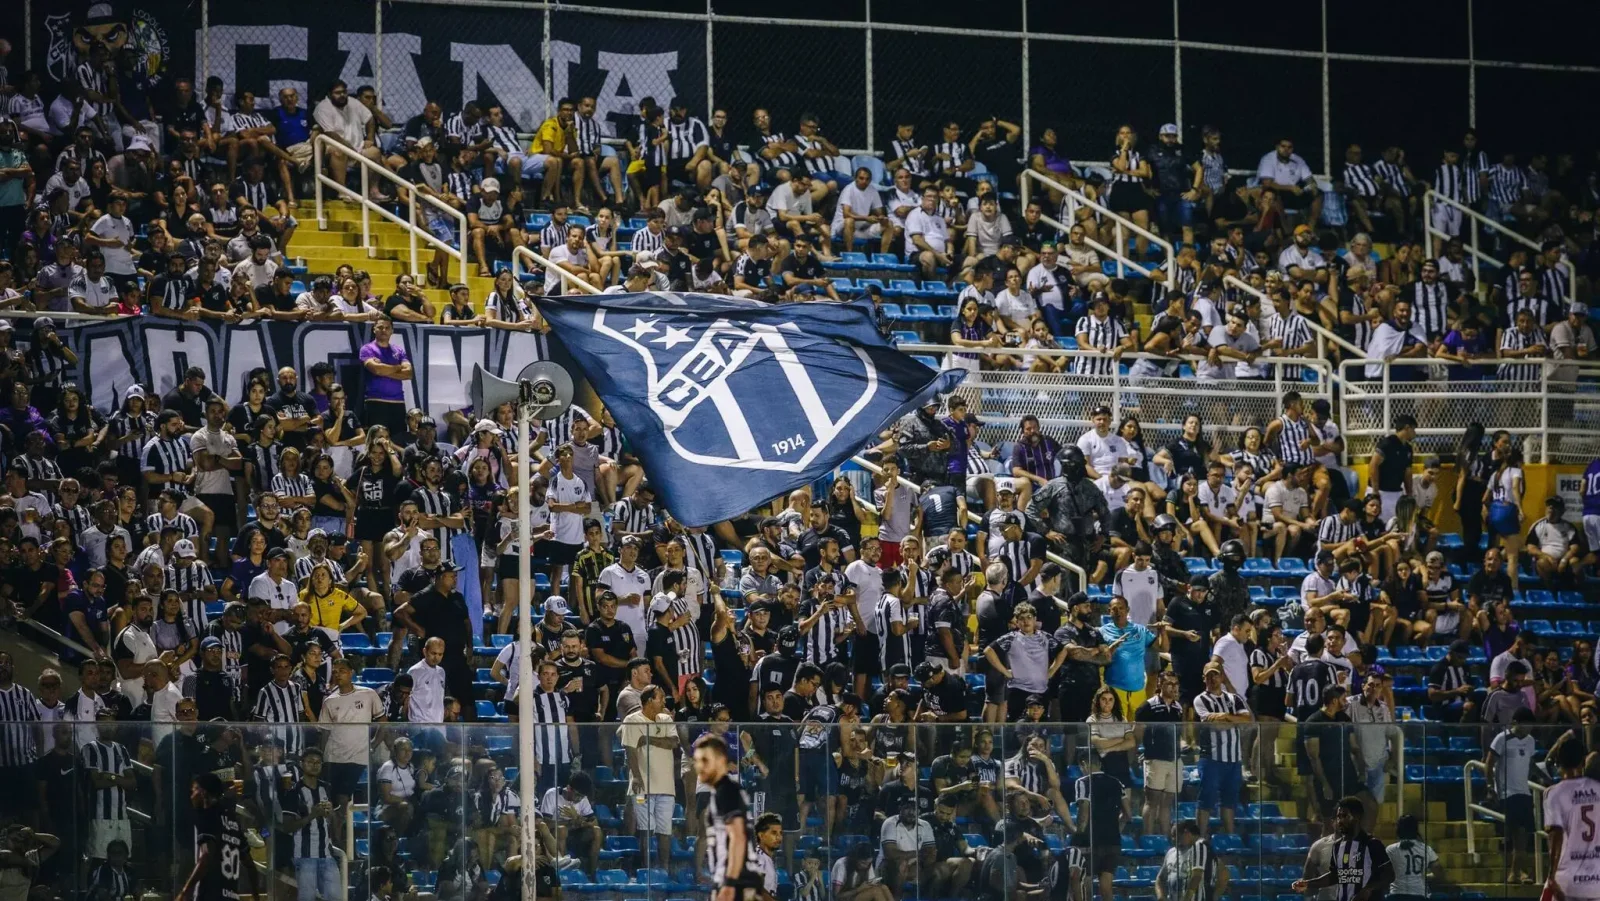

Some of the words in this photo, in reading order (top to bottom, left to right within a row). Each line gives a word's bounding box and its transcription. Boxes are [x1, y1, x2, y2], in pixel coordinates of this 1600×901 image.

[195, 25, 679, 138] CANA
[772, 433, 805, 456] 1914
[928, 493, 943, 513] 1
[1296, 678, 1319, 706] 10
[1581, 804, 1596, 843] 5
[1403, 853, 1425, 876] 10
